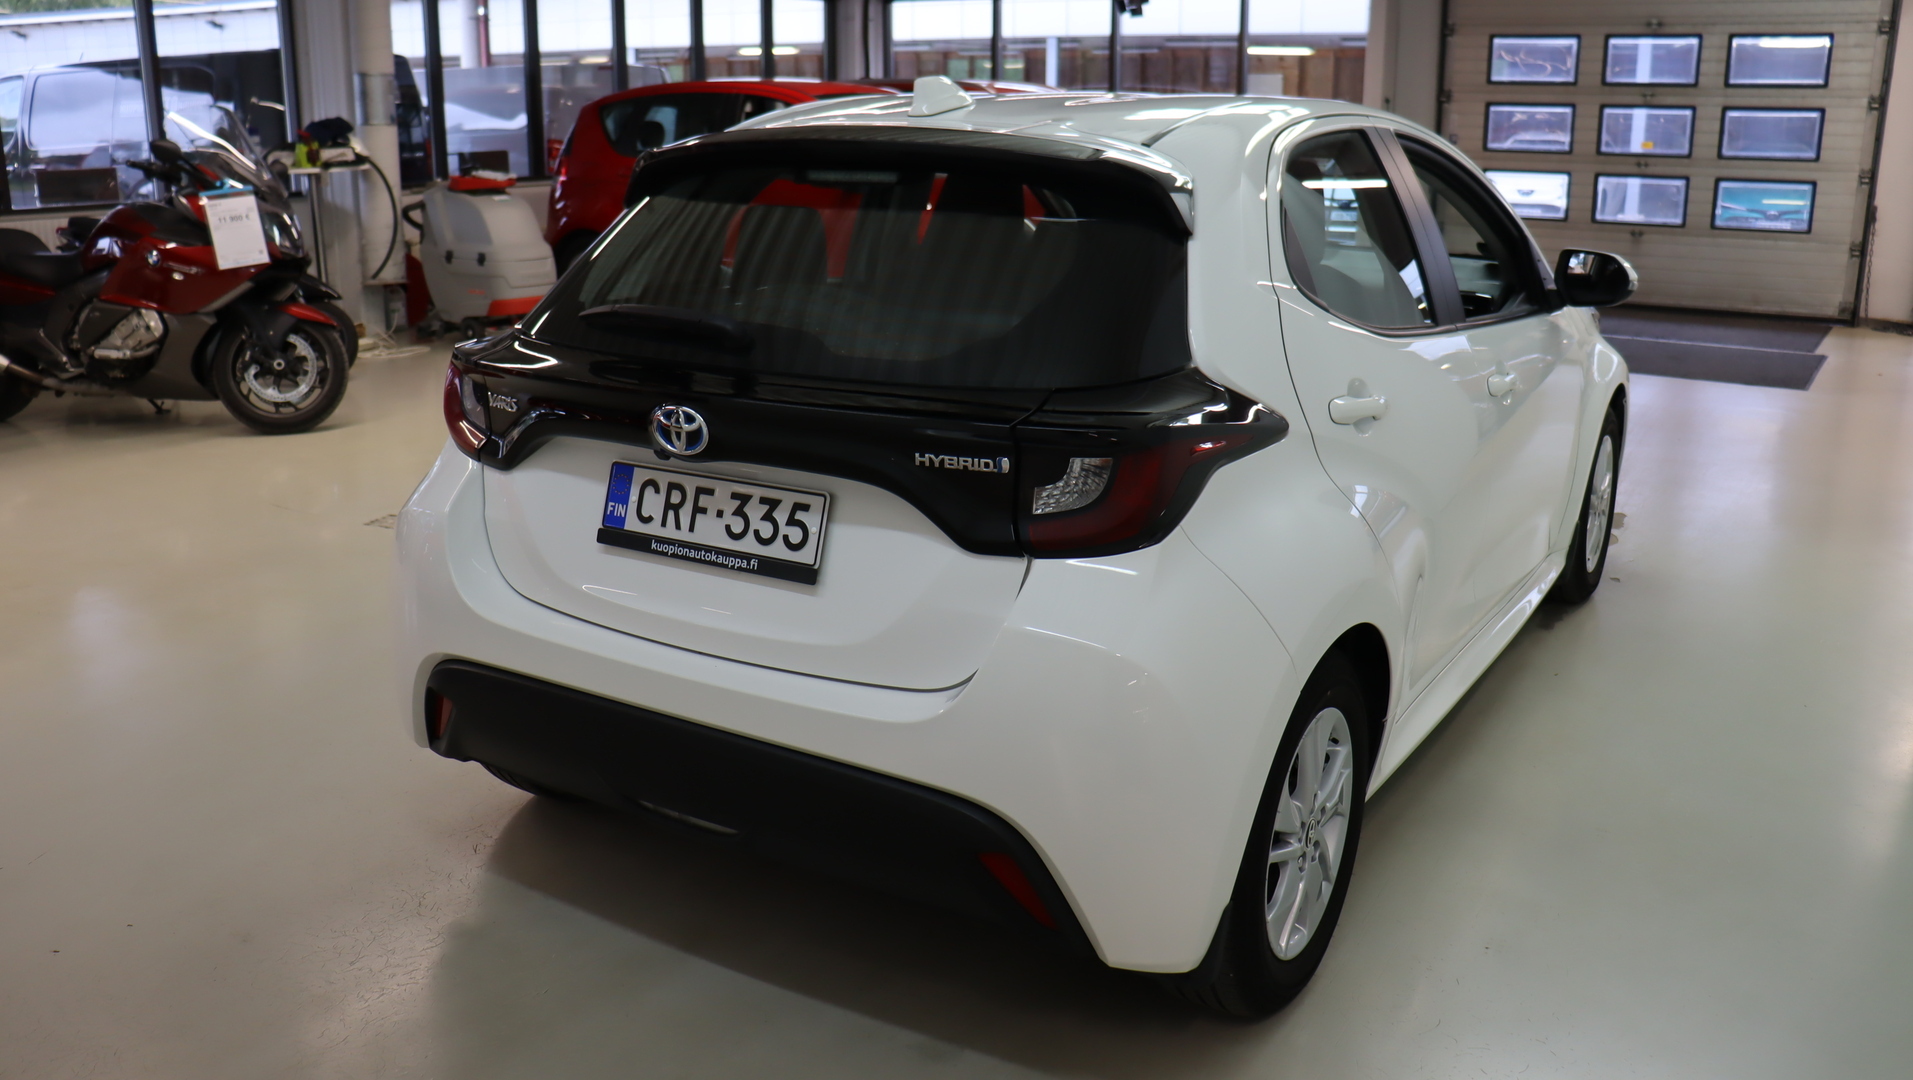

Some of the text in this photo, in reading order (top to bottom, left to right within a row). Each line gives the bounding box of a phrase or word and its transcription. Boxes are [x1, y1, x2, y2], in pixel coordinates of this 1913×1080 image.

[488, 391, 518, 412] YARIS
[914, 452, 995, 473] HYBRID
[607, 502, 627, 518] FIN
[635, 478, 811, 552] CRF-335
[650, 539, 758, 571] kuopionautokauppa.fi
